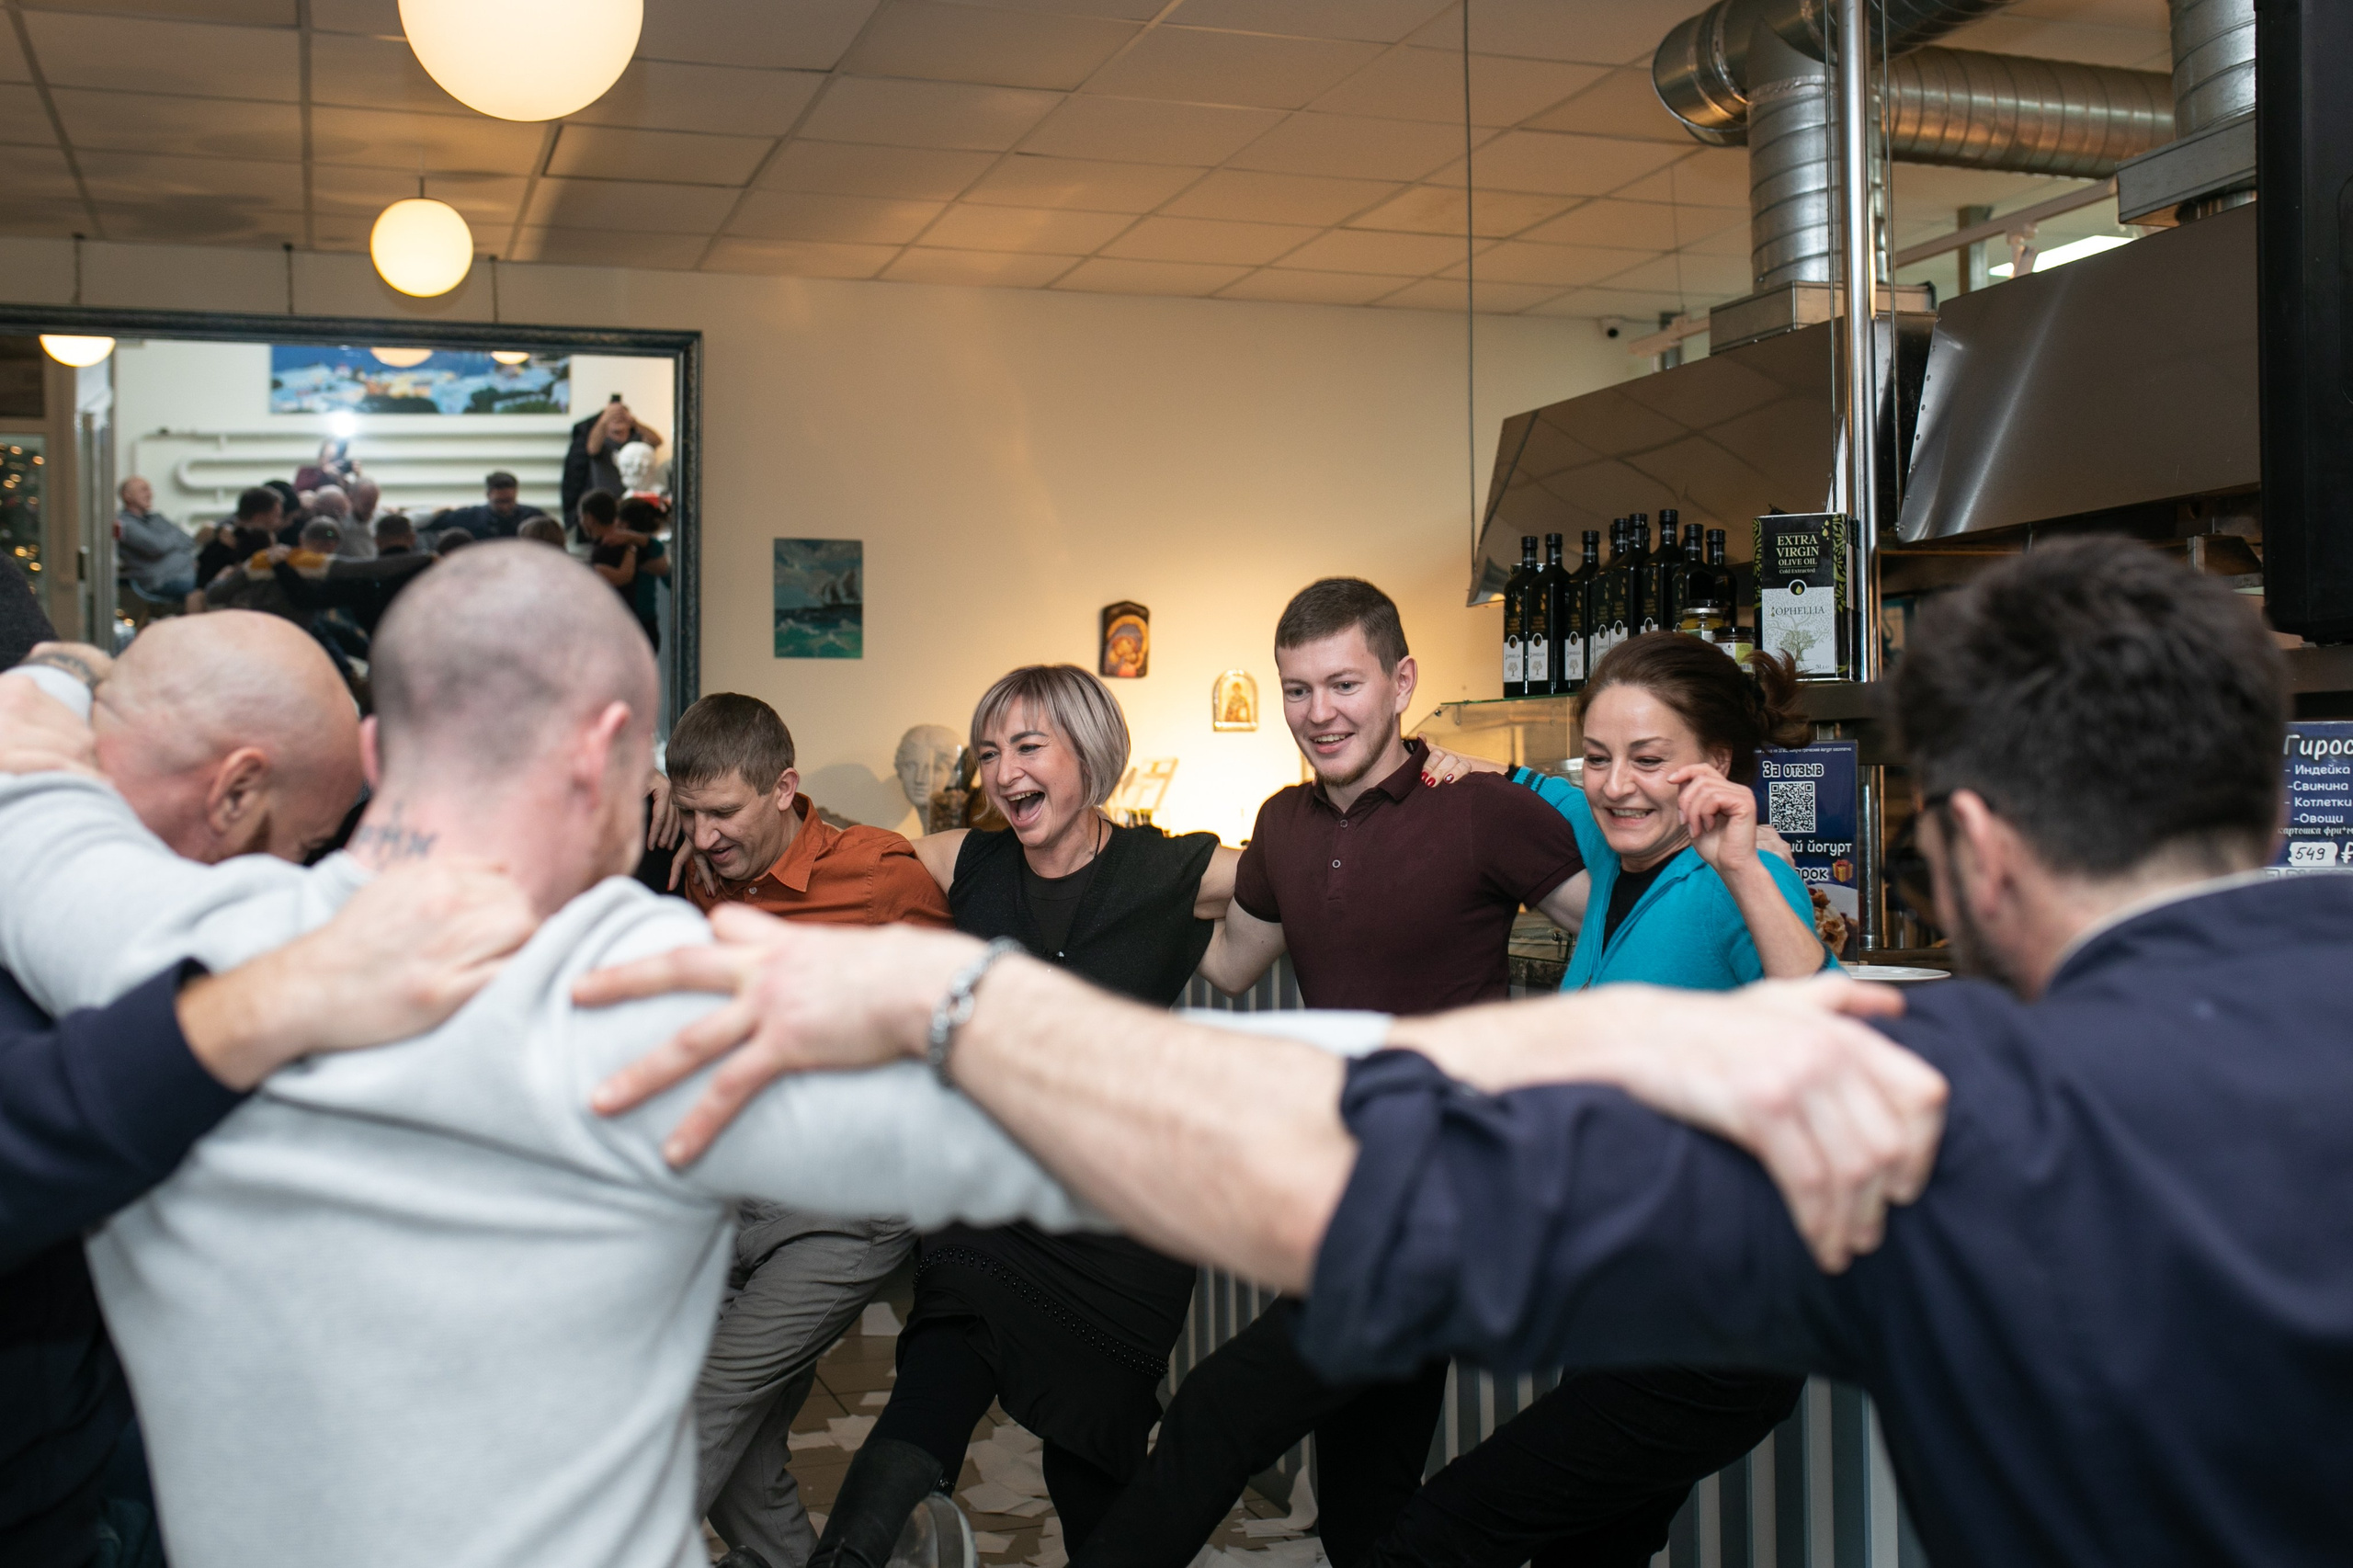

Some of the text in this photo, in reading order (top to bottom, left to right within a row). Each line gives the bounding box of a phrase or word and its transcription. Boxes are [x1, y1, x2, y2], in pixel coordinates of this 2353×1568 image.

[1777, 534, 1818, 546] EXTRA
[1776, 546, 1820, 558] VIRGIN
[1778, 558, 1802, 566] OLIVE
[1775, 606, 1825, 616] OPHELLIA
[1762, 761, 1824, 778] За отзыв
[2294, 764, 2351, 776] Индейка
[2287, 780, 2349, 791] -Свинина
[2294, 797, 2353, 808] Котлетки
[2293, 812, 2344, 824] -Овощи
[1807, 839, 1853, 857] йогурт
[2295, 846, 2326, 861] 549
